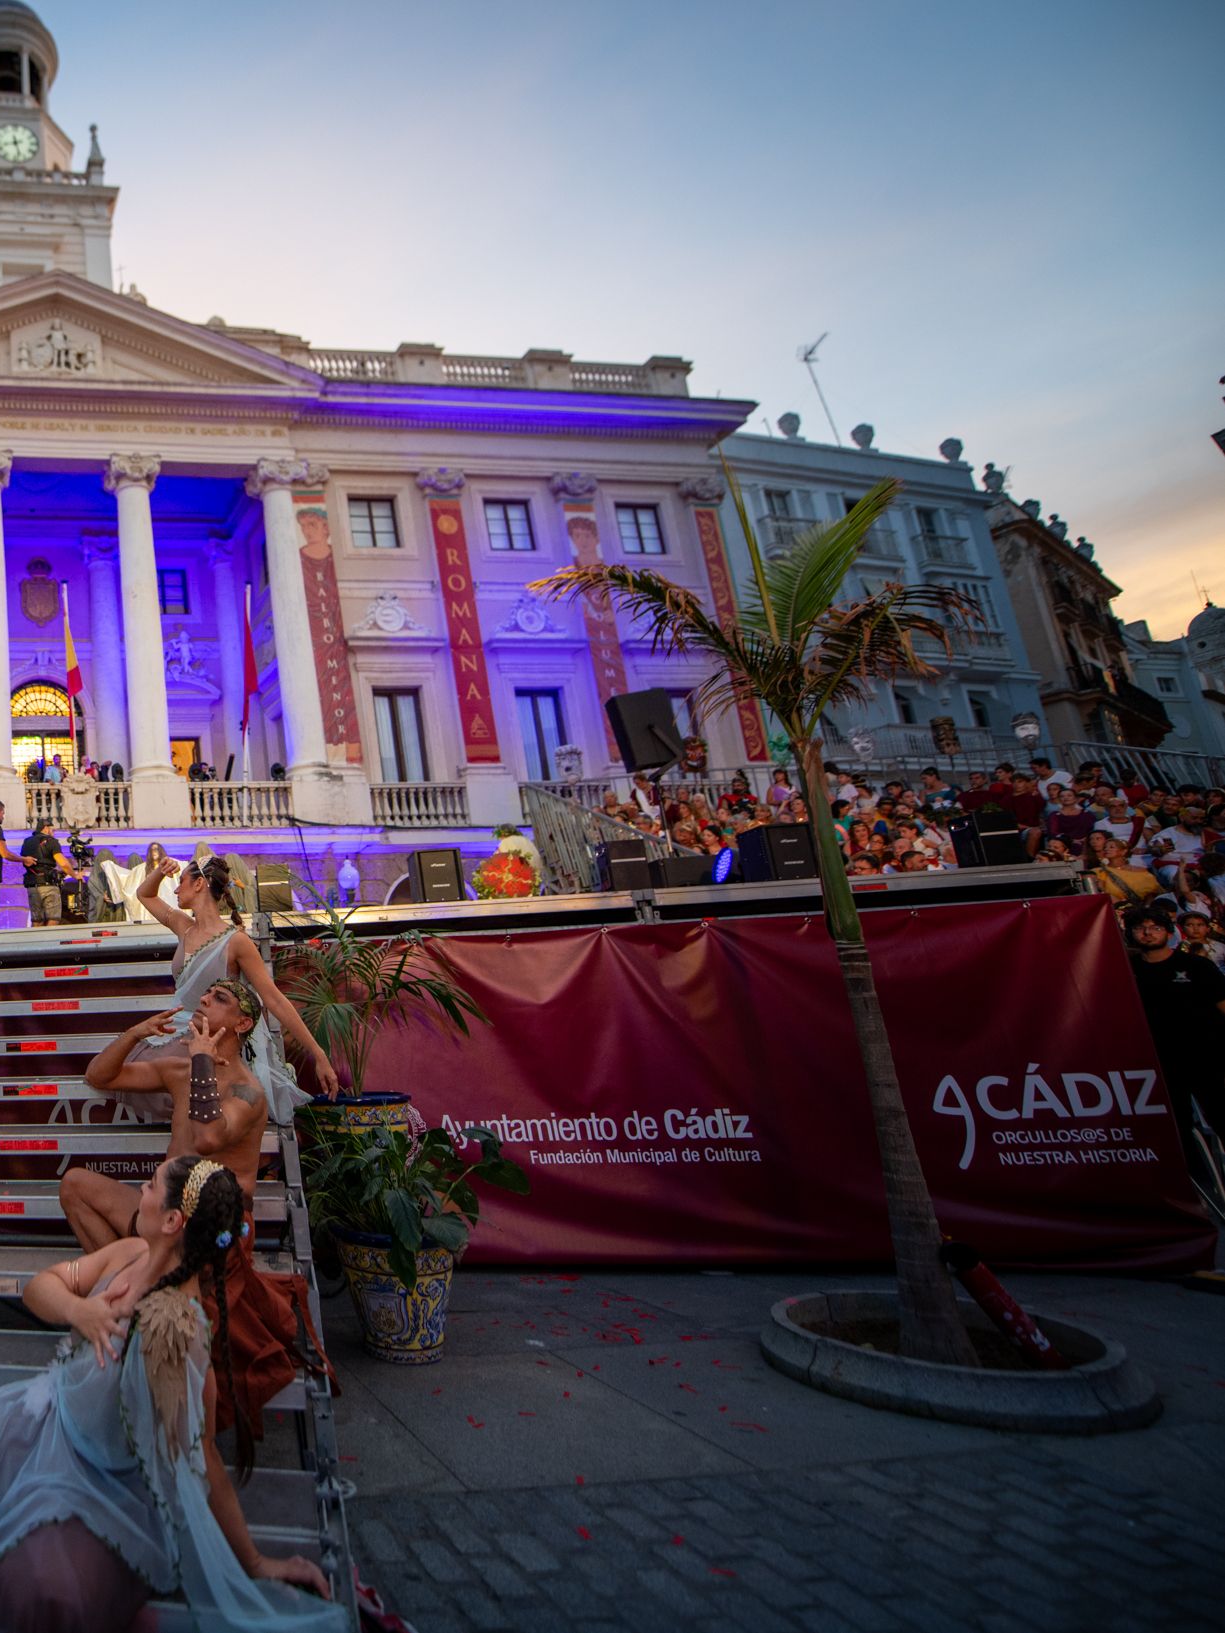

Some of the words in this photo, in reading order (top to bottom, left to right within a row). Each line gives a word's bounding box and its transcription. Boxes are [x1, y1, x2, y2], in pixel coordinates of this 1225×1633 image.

[445, 548, 482, 700] ROMANA
[316, 571, 334, 644] BALBO
[327, 659, 346, 734] MENOR
[623, 1110, 659, 1140] de
[664, 1106, 753, 1139] Cádiz
[992, 1127, 1108, 1145] ORGULLOS@S
[1112, 1127, 1134, 1141] DE
[529, 1148, 603, 1166] Fundación
[606, 1147, 677, 1165] Municipal
[681, 1147, 701, 1162] de
[704, 1146, 762, 1163] Cultura
[998, 1150, 1078, 1166] NUESTRA
[1079, 1148, 1160, 1164] HISTORIA
[85, 1161, 139, 1173] NUESTRA
